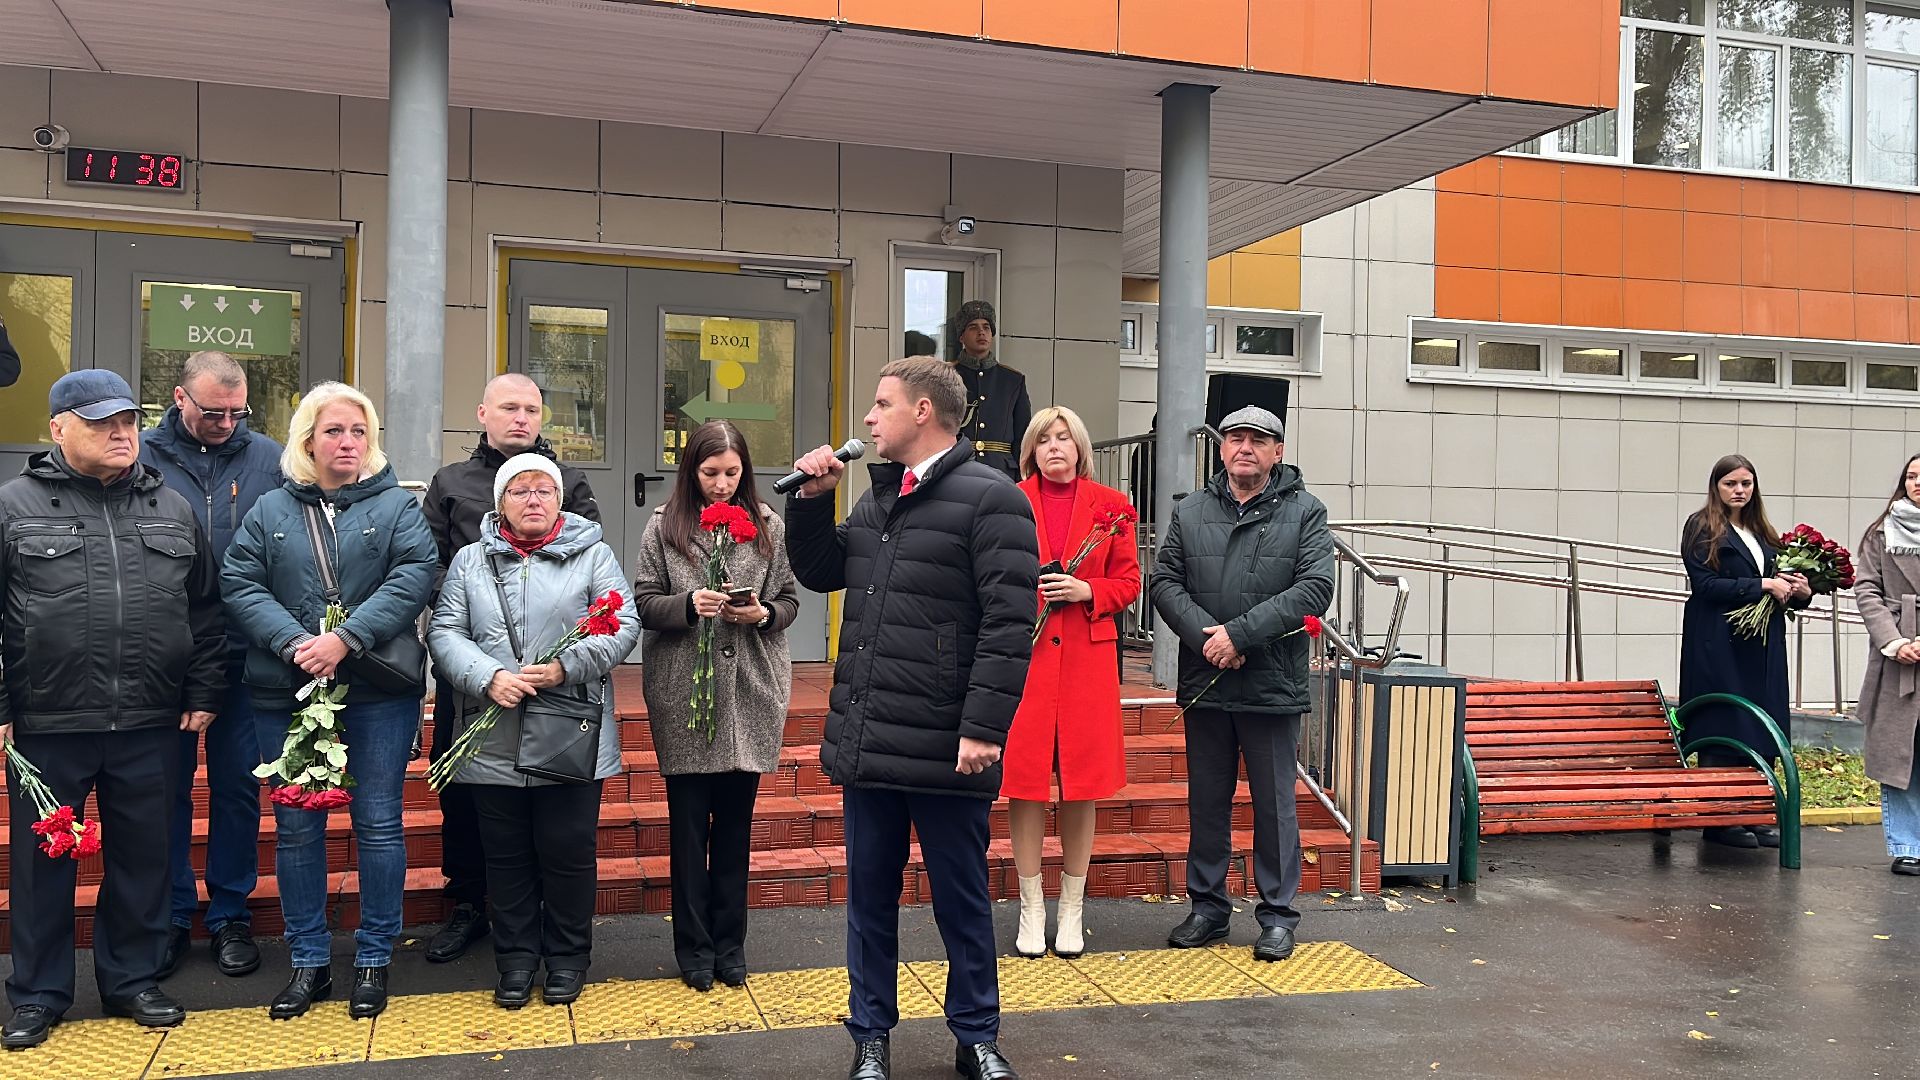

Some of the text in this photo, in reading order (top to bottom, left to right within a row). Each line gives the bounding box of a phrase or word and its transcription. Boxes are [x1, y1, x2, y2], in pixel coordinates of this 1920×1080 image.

[84, 153, 180, 187] 11 38
[188, 325, 254, 349] ВХОД
[710, 334, 750, 349] ВХОД
